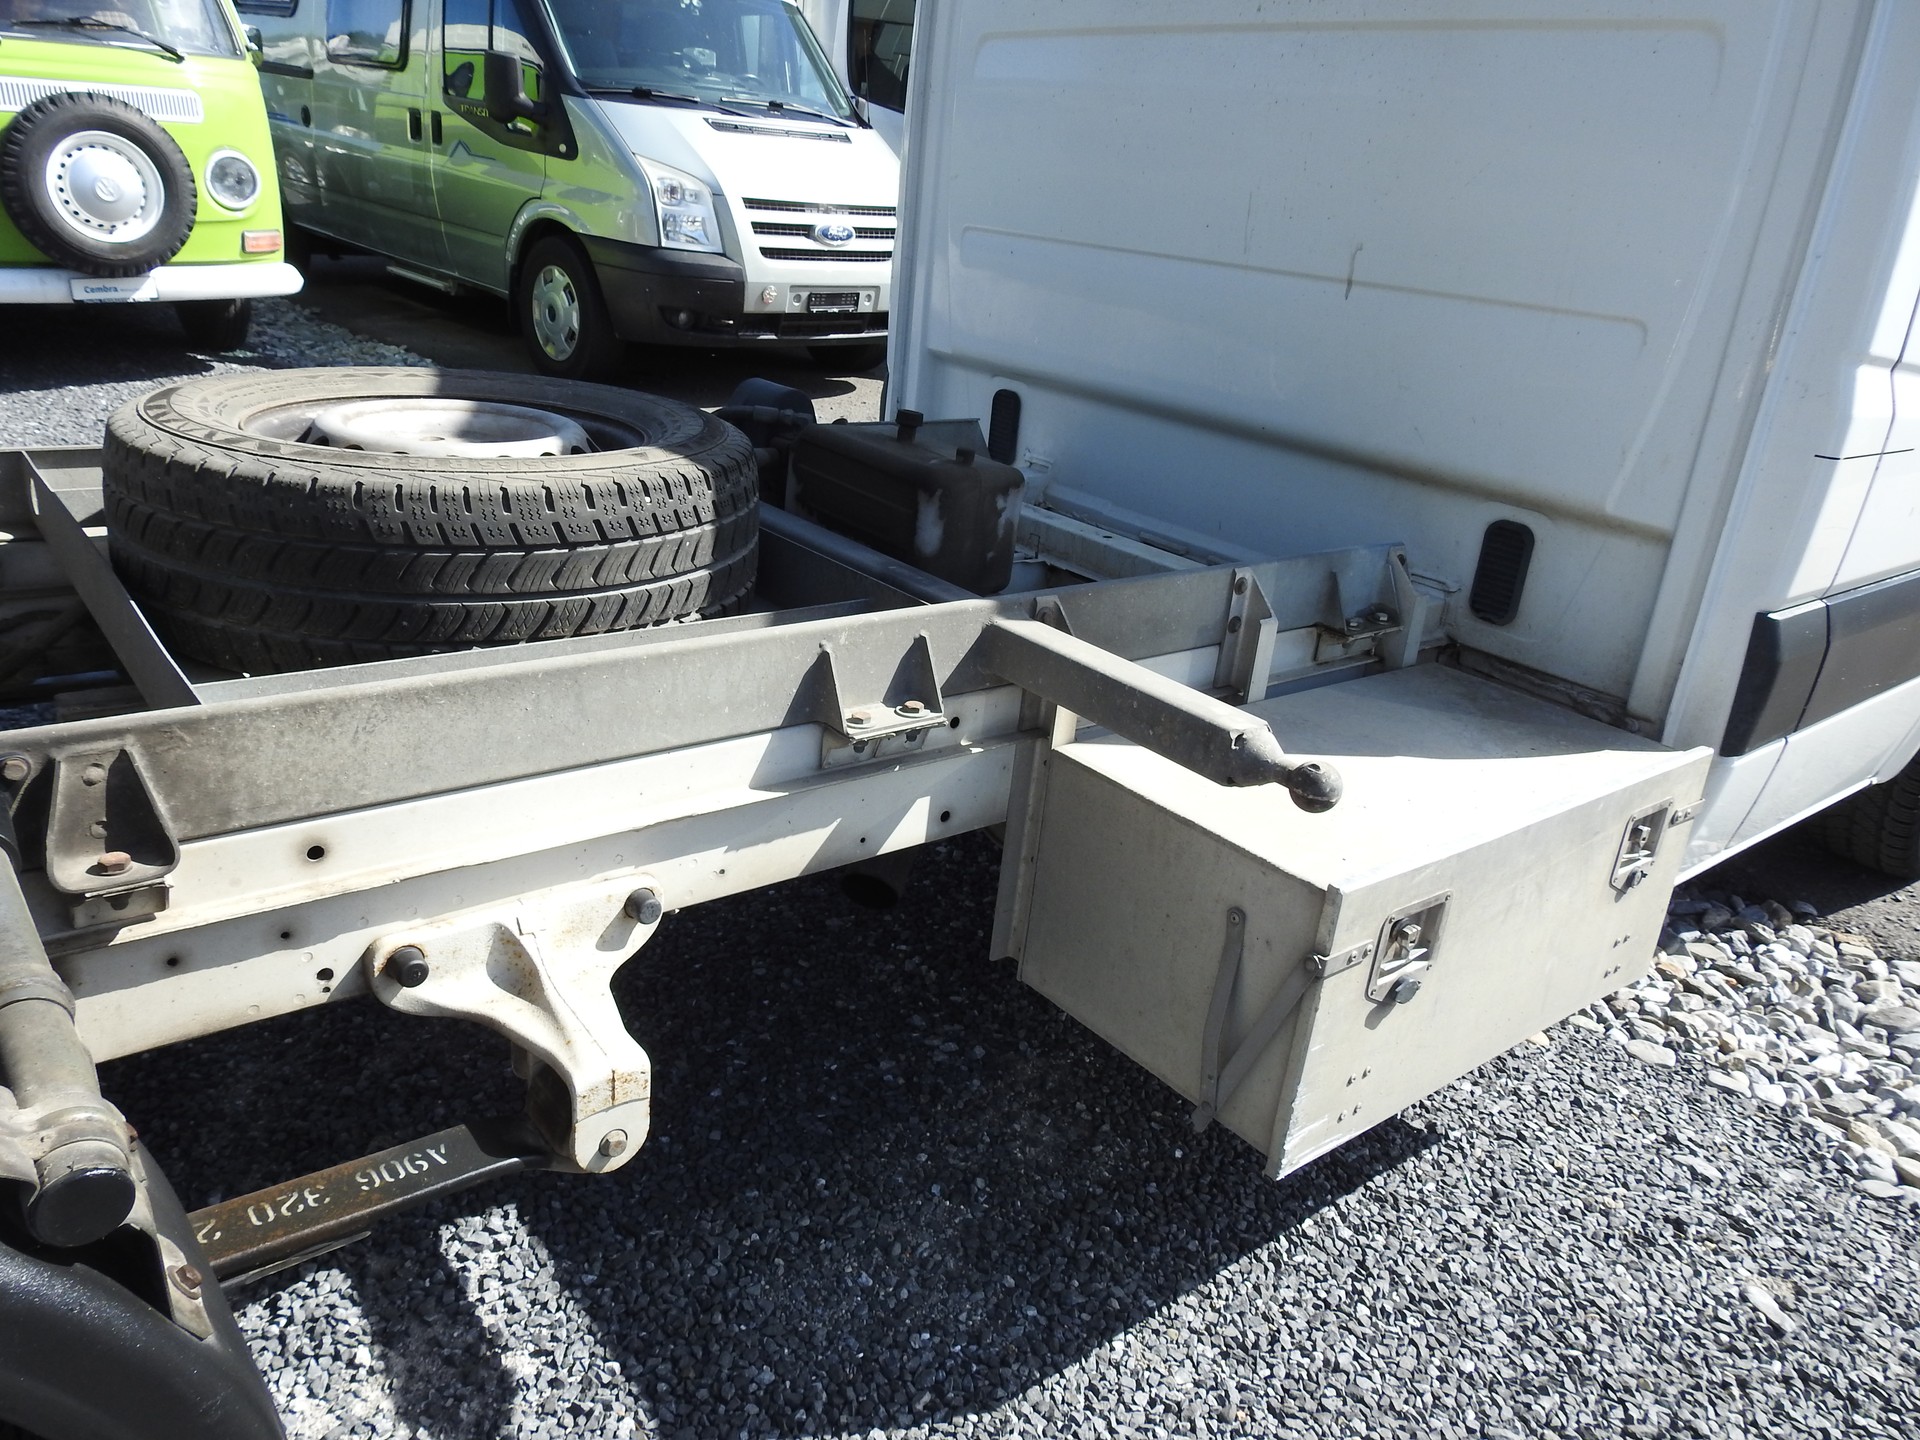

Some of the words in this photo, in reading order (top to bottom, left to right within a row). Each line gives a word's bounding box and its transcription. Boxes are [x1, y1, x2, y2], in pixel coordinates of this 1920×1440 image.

[83, 285, 119, 294] Cembra
[355, 1143, 448, 1191] A906
[247, 1184, 331, 1226] 320
